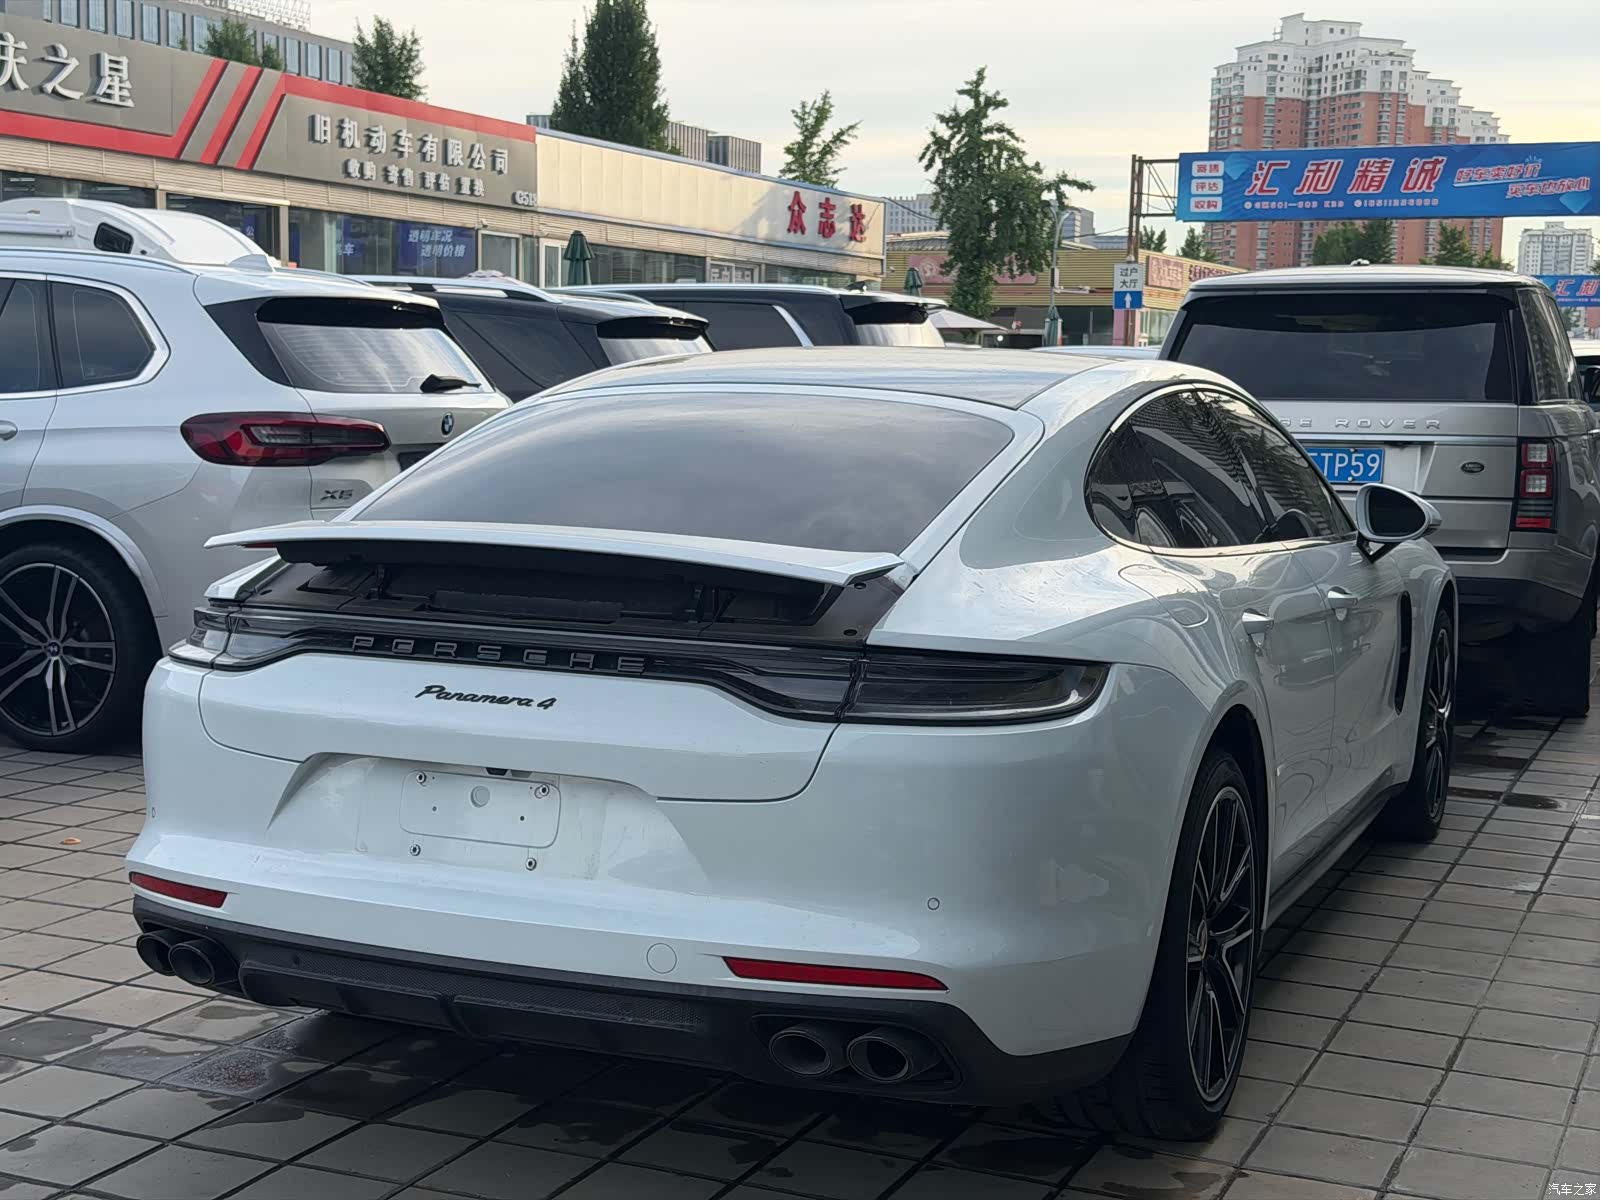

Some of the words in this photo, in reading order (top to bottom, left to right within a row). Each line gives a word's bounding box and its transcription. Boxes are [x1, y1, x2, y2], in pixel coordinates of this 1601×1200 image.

[311, 113, 509, 175] 旧机动车有限公司
[1244, 156, 1447, 195] 汇利精诚
[1454, 163, 1542, 183] 好车卖好价
[787, 190, 867, 243] 众志达
[1119, 267, 1139, 278] 过户
[1119, 279, 1138, 289] 大厅
[1335, 418, 1440, 430] ROVER
[1309, 452, 1380, 478] TP59
[351, 635, 646, 675] PORSCHE
[414, 684, 534, 707] Panamera
[536, 697, 557, 710] 4
